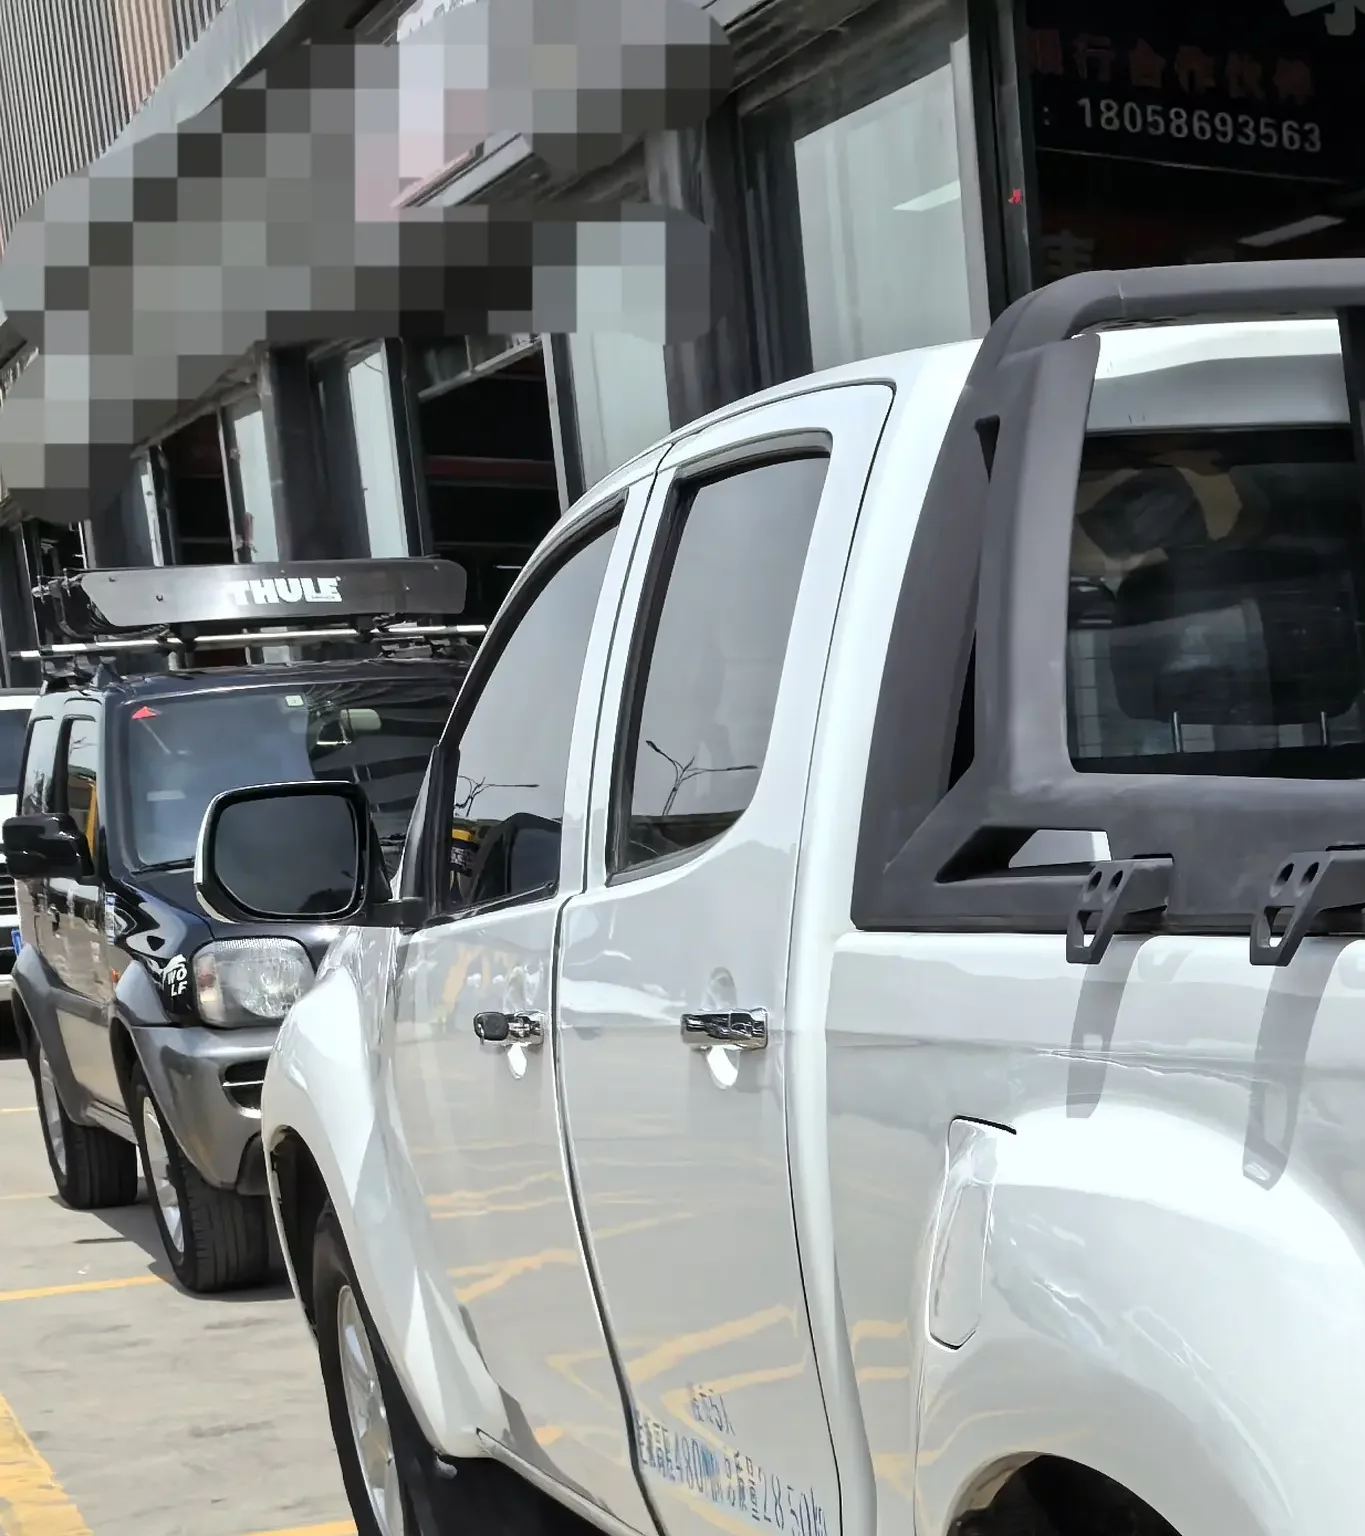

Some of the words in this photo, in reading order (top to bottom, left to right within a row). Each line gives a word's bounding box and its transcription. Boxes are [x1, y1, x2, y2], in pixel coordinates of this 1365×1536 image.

[1077, 97, 1322, 152] 18058693563
[225, 577, 342, 606] THULE
[171, 981, 187, 996] LF
